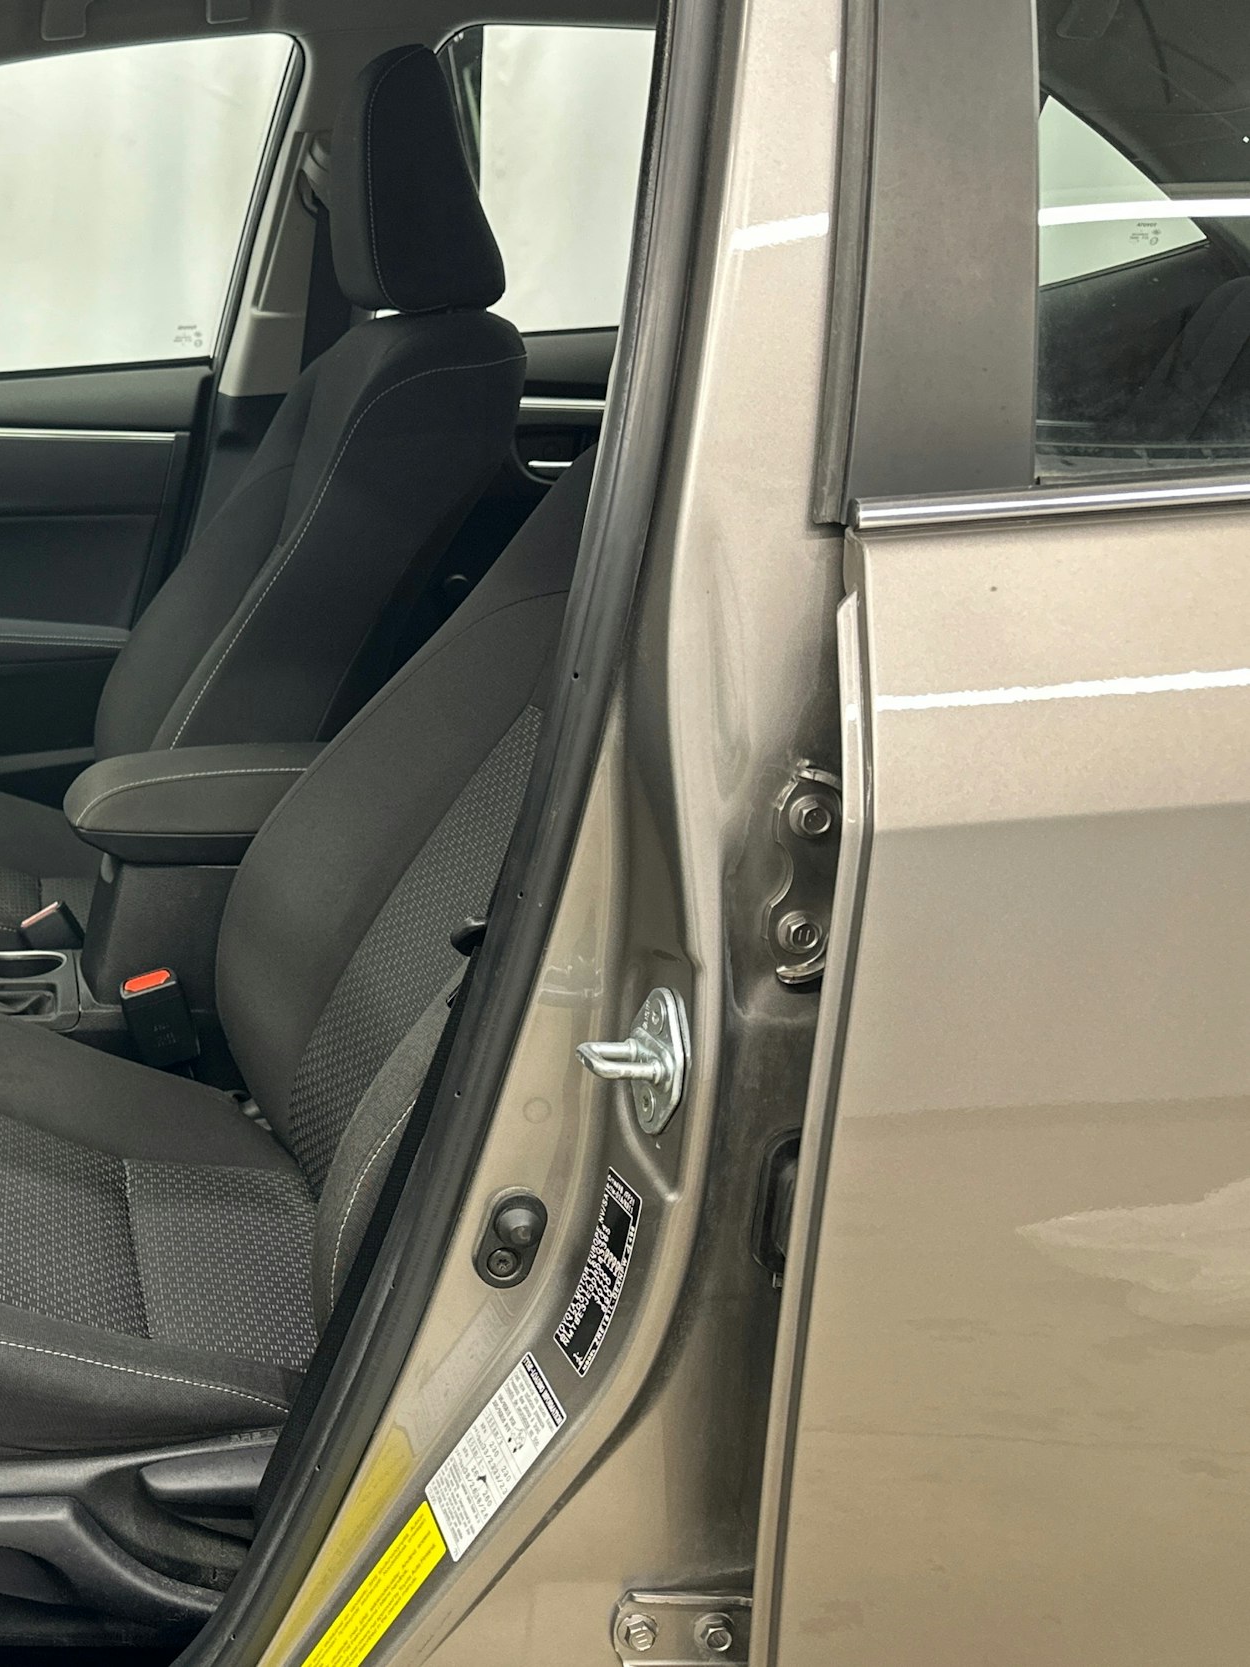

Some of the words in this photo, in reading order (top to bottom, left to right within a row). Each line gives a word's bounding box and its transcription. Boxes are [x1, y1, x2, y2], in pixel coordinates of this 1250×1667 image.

[555, 1299, 576, 1338] TOYOTA
[573, 1265, 590, 1301] MOTOR
[586, 1224, 602, 1266] EUROPE
[597, 1190, 609, 1225] NV/SA
